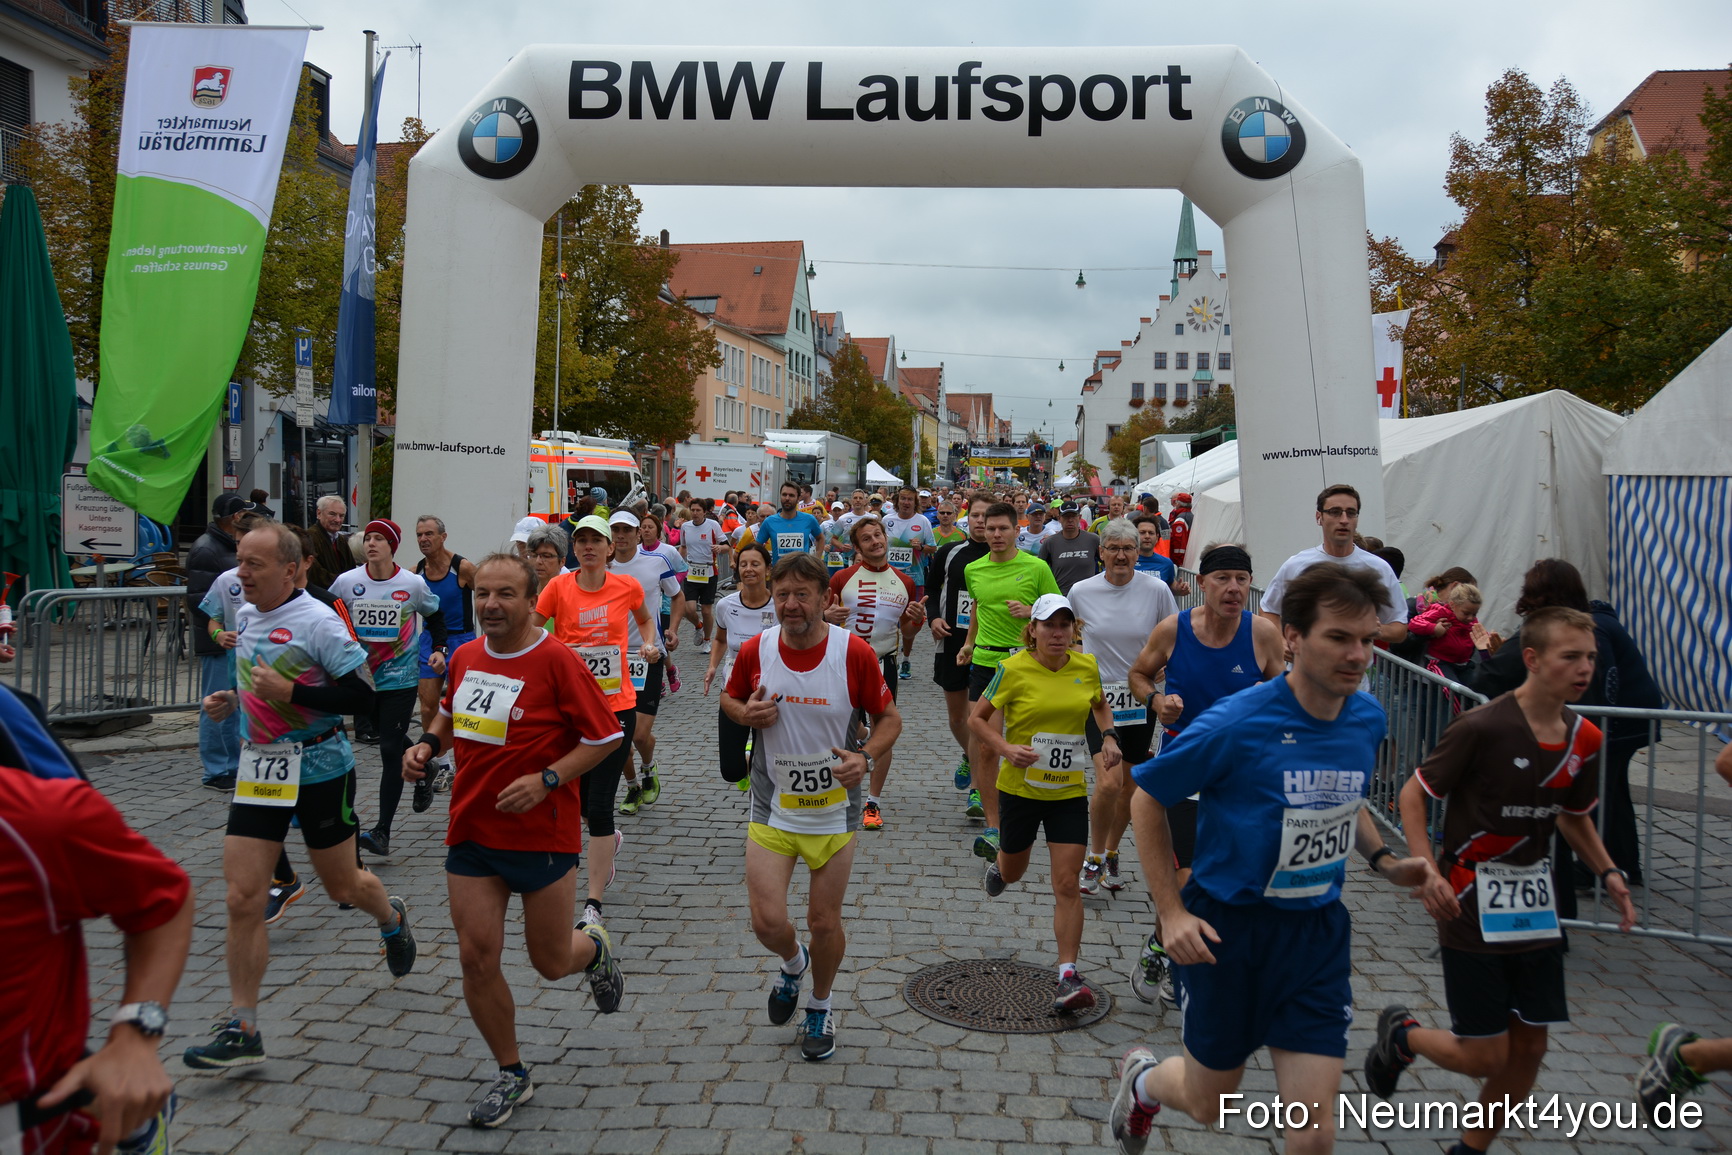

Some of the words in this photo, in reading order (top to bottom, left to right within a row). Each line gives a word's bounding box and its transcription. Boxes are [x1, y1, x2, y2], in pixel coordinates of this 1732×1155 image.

[568, 61, 785, 120] BMW
[807, 61, 1193, 136] Laufsport
[469, 99, 532, 125] BMW
[1229, 98, 1297, 125] BMW
[231, 388, 239, 418] P
[258, 438, 264, 451] 3
[396, 441, 506, 456] www.bmw-laufsport.de
[1262, 444, 1379, 460] www.bmw-laufsport.de
[75, 503, 108, 513] Kreuzung
[110, 504, 126, 512] über
[89, 514, 112, 522] Untere
[78, 523, 123, 533] Kaserngasse
[780, 538, 802, 548] 2276
[889, 552, 911, 562] 2642
[692, 568, 705, 576] 514
[358, 610, 397, 625] 2592
[579, 605, 609, 624] RUNWAY
[466, 688, 495, 714] 24
[785, 695, 831, 706] KLEBL
[1033, 737, 1054, 745] PARTL
[775, 759, 797, 767] PARTL
[798, 756, 831, 767] Neumarkt
[1049, 747, 1073, 769] 85
[252, 757, 289, 781] 173
[789, 766, 833, 793] 259
[1043, 772, 1070, 783] Marion
[1283, 770, 1365, 793] HUBER
[253, 785, 282, 797] Roland
[798, 797, 828, 807] Rainer
[1286, 817, 1319, 829] PARTL
[1288, 820, 1351, 867] 2550
[1487, 877, 1550, 909] 2768
